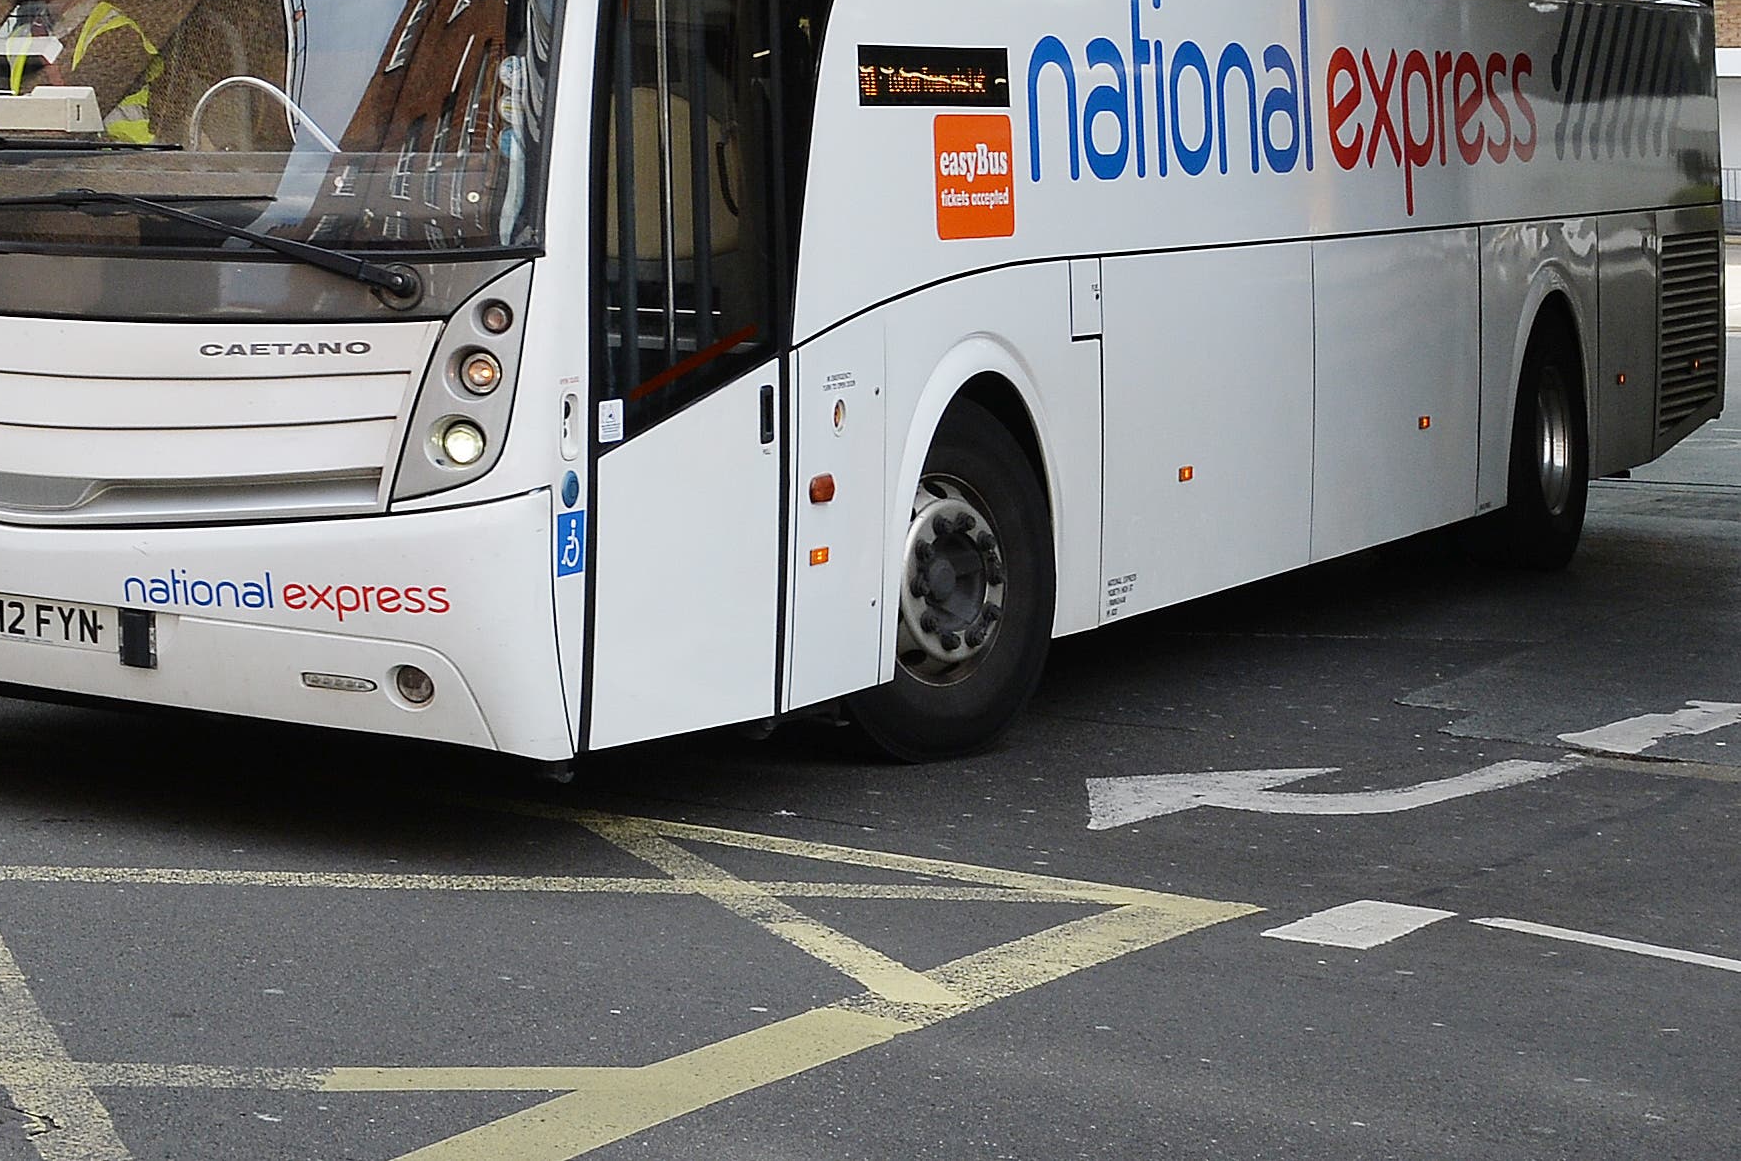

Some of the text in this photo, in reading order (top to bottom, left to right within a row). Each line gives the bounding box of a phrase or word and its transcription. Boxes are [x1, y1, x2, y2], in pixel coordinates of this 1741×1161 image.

[1326, 46, 1537, 217] express
[939, 143, 1009, 183] easyBus
[941, 186, 1010, 209] tickets accepted
[199, 341, 371, 356] CAETANO
[123, 568, 451, 622] national express
[35, 603, 99, 644] FYN
